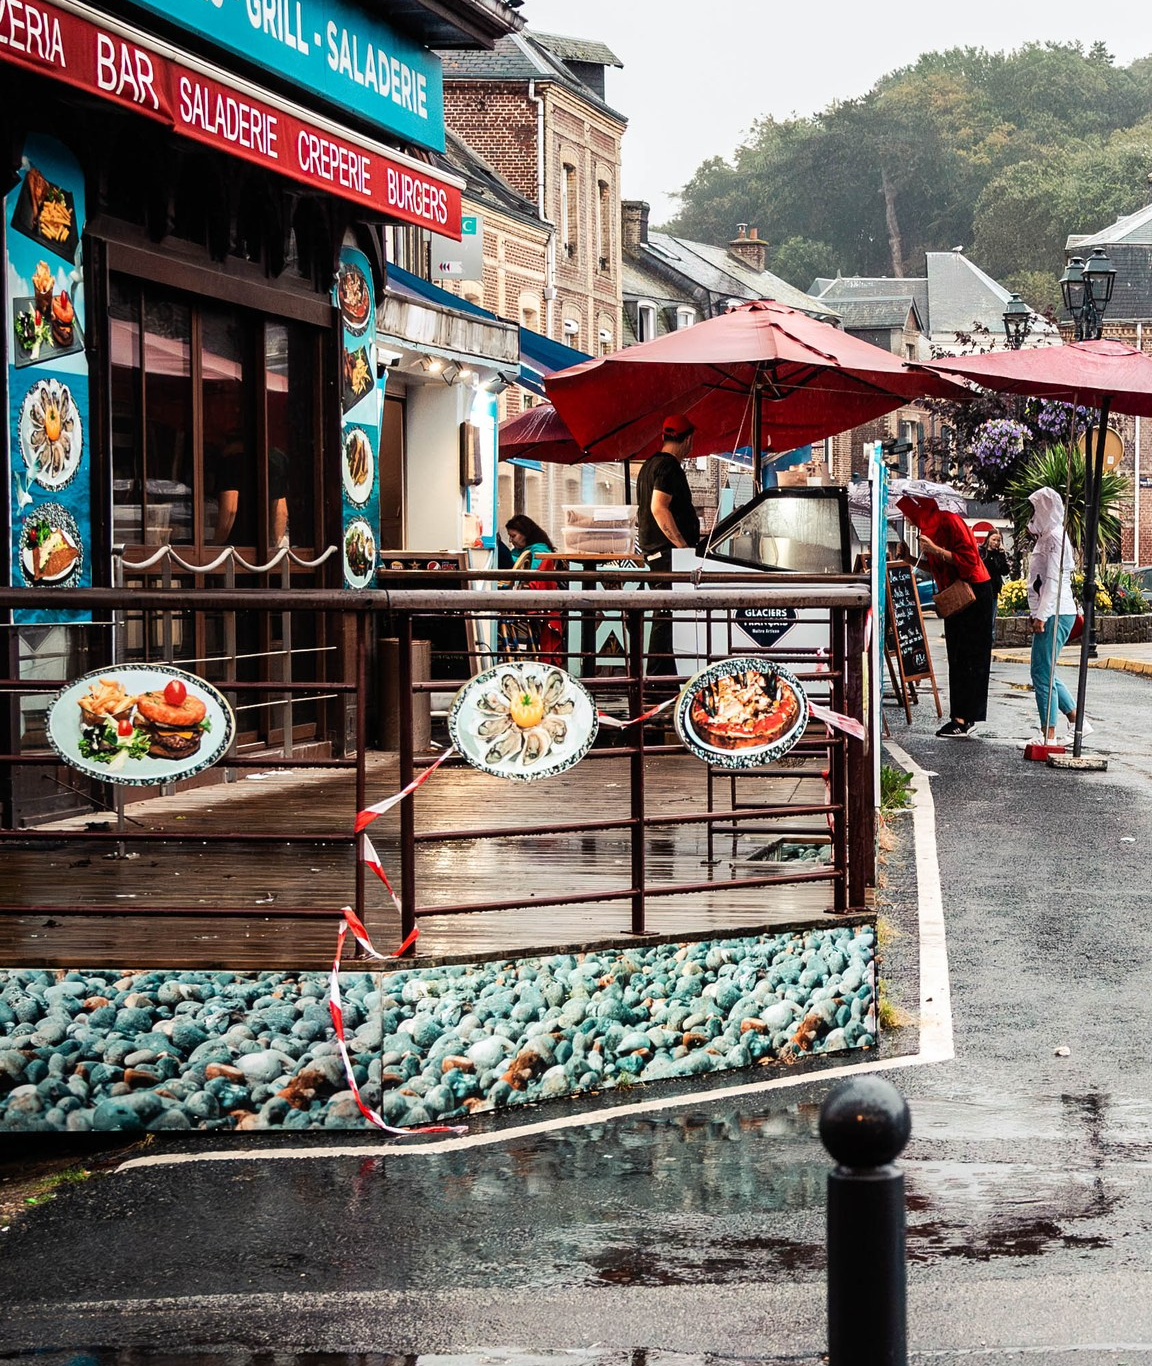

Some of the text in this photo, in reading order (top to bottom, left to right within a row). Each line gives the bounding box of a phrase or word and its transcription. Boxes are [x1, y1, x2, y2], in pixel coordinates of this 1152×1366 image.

[326, 20, 428, 120] SALADERIE
[97, 32, 159, 110] BAR
[179, 76, 278, 159] SALADERIE
[297, 130, 371, 196] CREPERIE
[387, 167, 448, 224] BURGERS
[744, 608, 788, 617] GLACIERS
